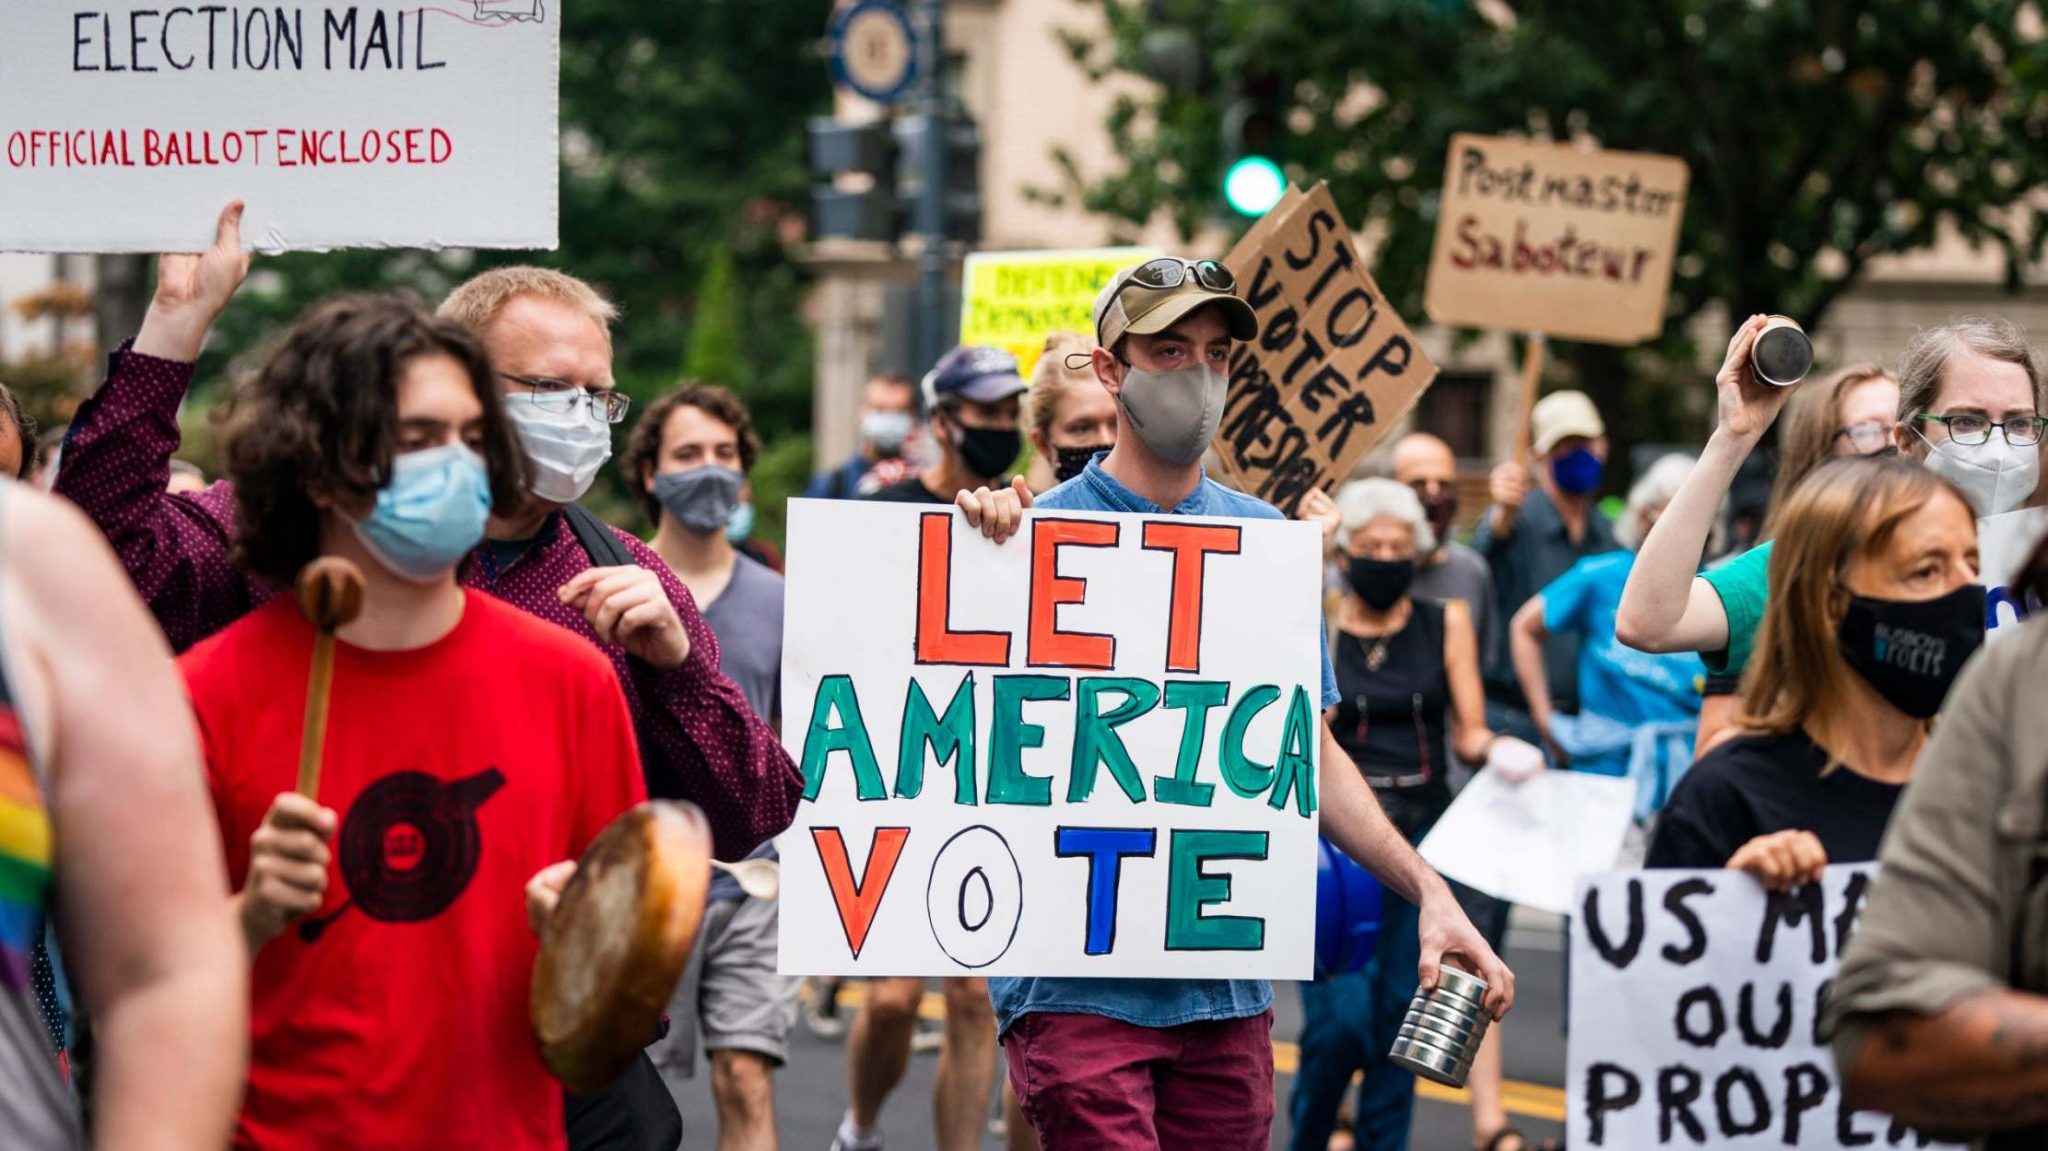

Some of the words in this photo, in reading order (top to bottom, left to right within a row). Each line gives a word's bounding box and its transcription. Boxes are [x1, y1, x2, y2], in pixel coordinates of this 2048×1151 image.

[73, 8, 301, 71] ELECTION
[324, 7, 446, 70] MAIL
[8, 130, 135, 167] OFFICIAL
[144, 129, 268, 167] BALLOT
[278, 129, 453, 167] ENCLOSED
[1285, 209, 1412, 382] STOP
[1450, 213, 1653, 284] Saboteur
[1248, 256, 1375, 461] VOTER
[913, 512, 1241, 673] LET
[800, 670, 1317, 818] AMERICA
[809, 824, 1269, 968] VOTE
[1584, 878, 1715, 968] US
[1675, 980, 1833, 1048] OU
